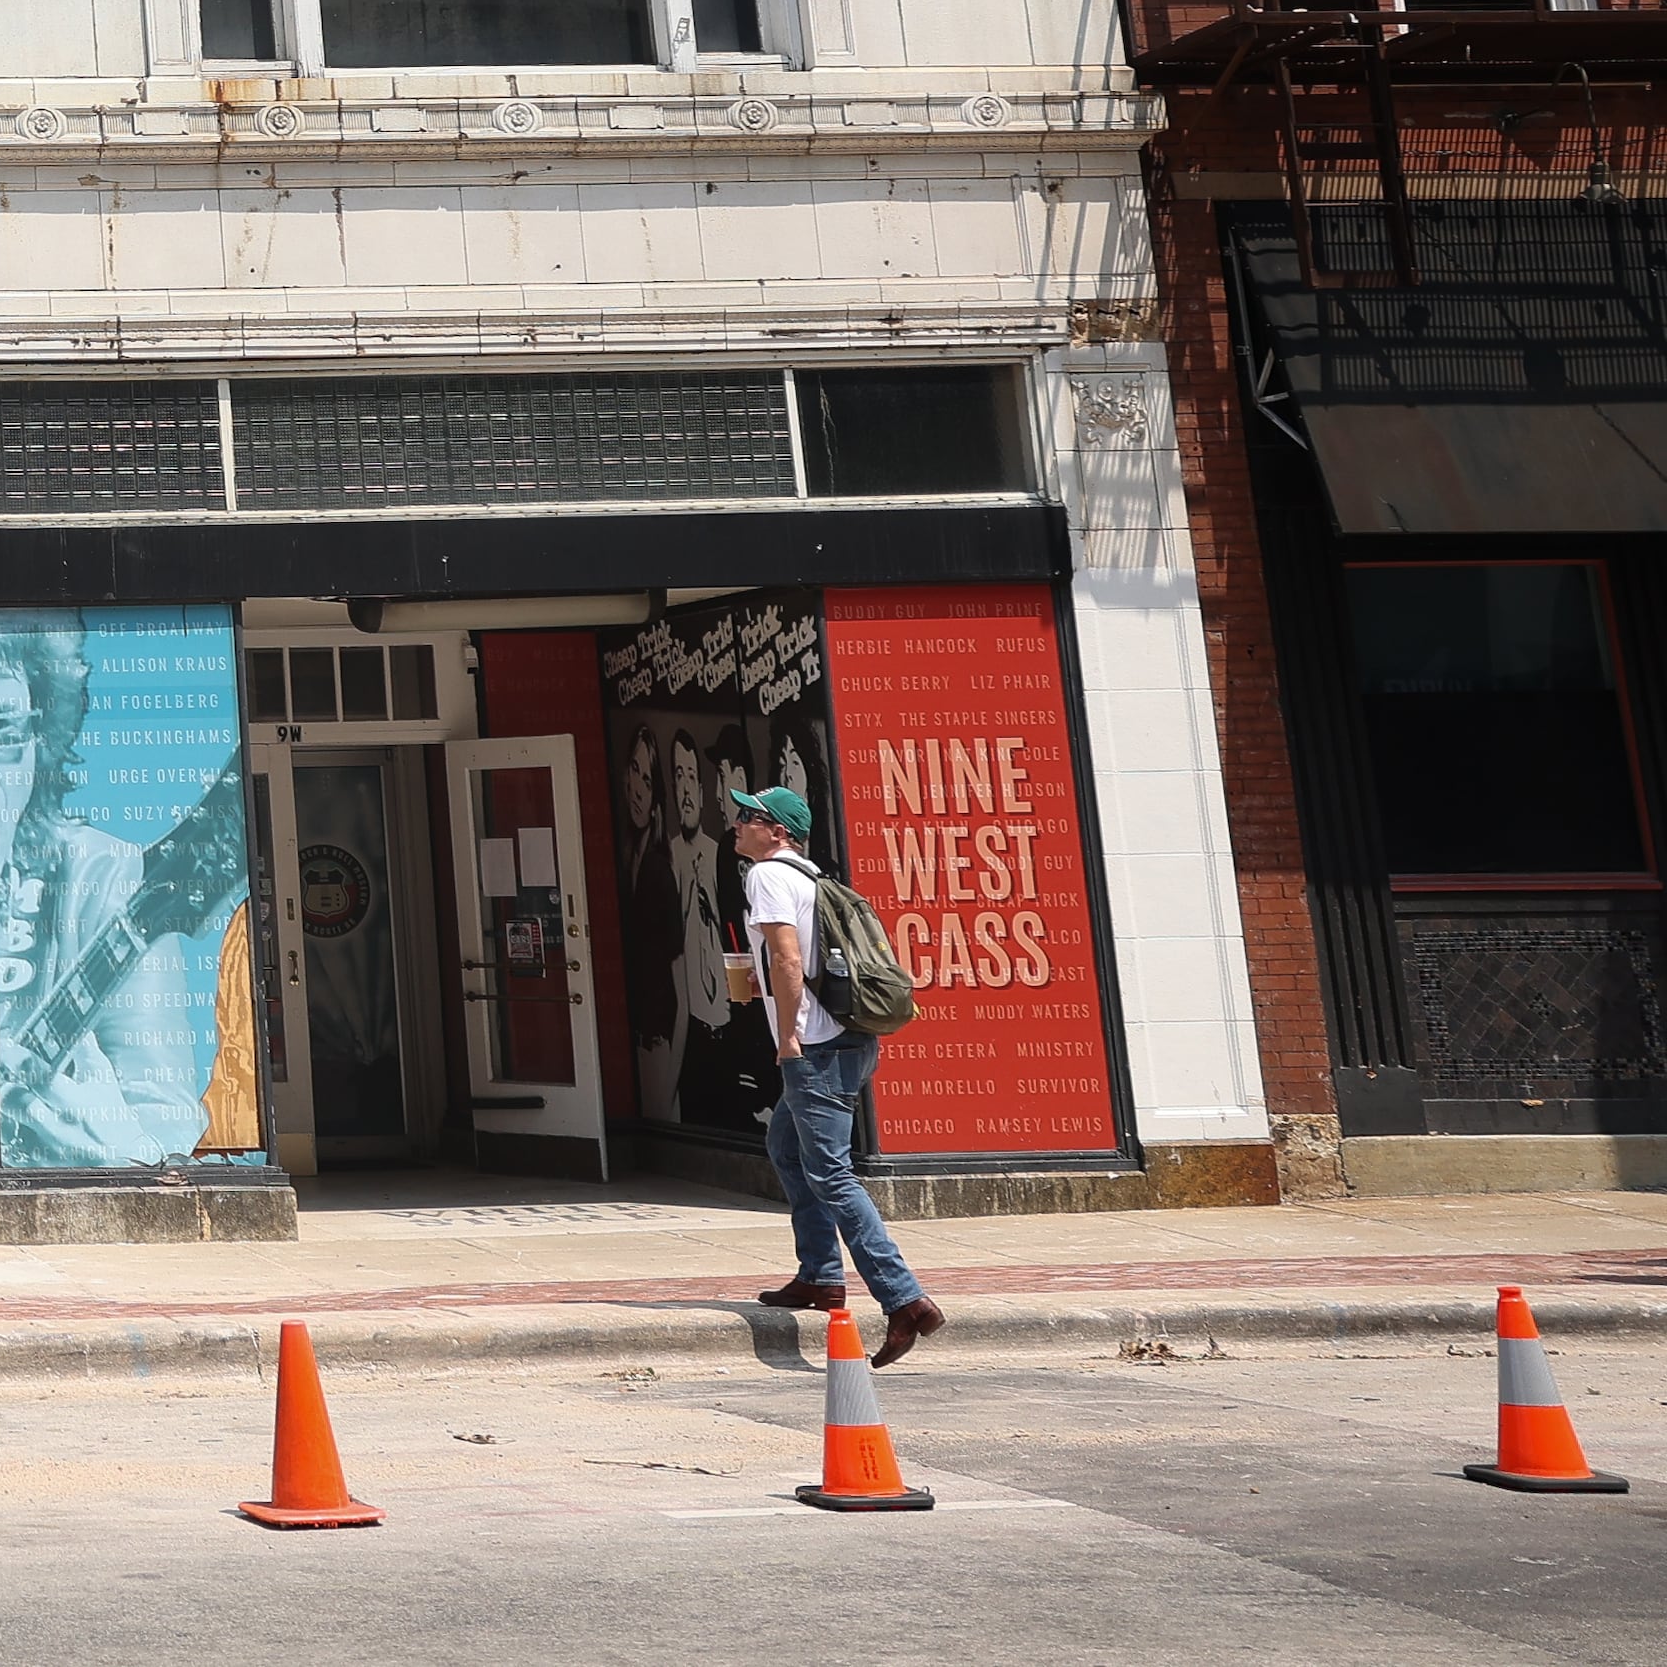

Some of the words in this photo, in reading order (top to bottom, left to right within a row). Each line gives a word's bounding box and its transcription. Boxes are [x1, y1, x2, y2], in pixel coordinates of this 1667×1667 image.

[836, 640, 891, 655] HERBIE
[904, 638, 977, 653] HANCOCK
[996, 638, 1045, 652] RUFUS
[102, 657, 167, 673] ALLISON
[174, 655, 227, 671] KRAUS
[841, 677, 893, 691] CHUCK
[901, 676, 949, 691] BERRY
[971, 675, 995, 689] LIZ
[1003, 675, 1050, 689] PHAIR
[121, 694, 218, 709] FOGELBERG
[845, 713, 882, 727] STYX
[899, 712, 927, 726] THE
[934, 712, 987, 726] STAPLE
[995, 711, 1056, 725] SINGERS
[110, 729, 231, 745] BUCKINGHAMS
[877, 737, 1033, 815] NINE
[883, 825, 1038, 901] WEST
[896, 911, 1050, 989] CASS
[920, 1006, 957, 1020] OOKE
[974, 1005, 1024, 1019] MUDDY
[1031, 1004, 1089, 1019] WATERS
[879, 1044, 927, 1059] PETER
[935, 1043, 996, 1058] CETERA
[1017, 1042, 1093, 1057] MINISTRY
[879, 1080, 913, 1096] TOM
[921, 1080, 995, 1095] MORELLO
[1017, 1078, 1100, 1093] SURVIVOR
[883, 1119, 954, 1134] CHICAGO
[976, 1118, 1041, 1134] RAMSEY
[1051, 1117, 1102, 1132] LEWIS
